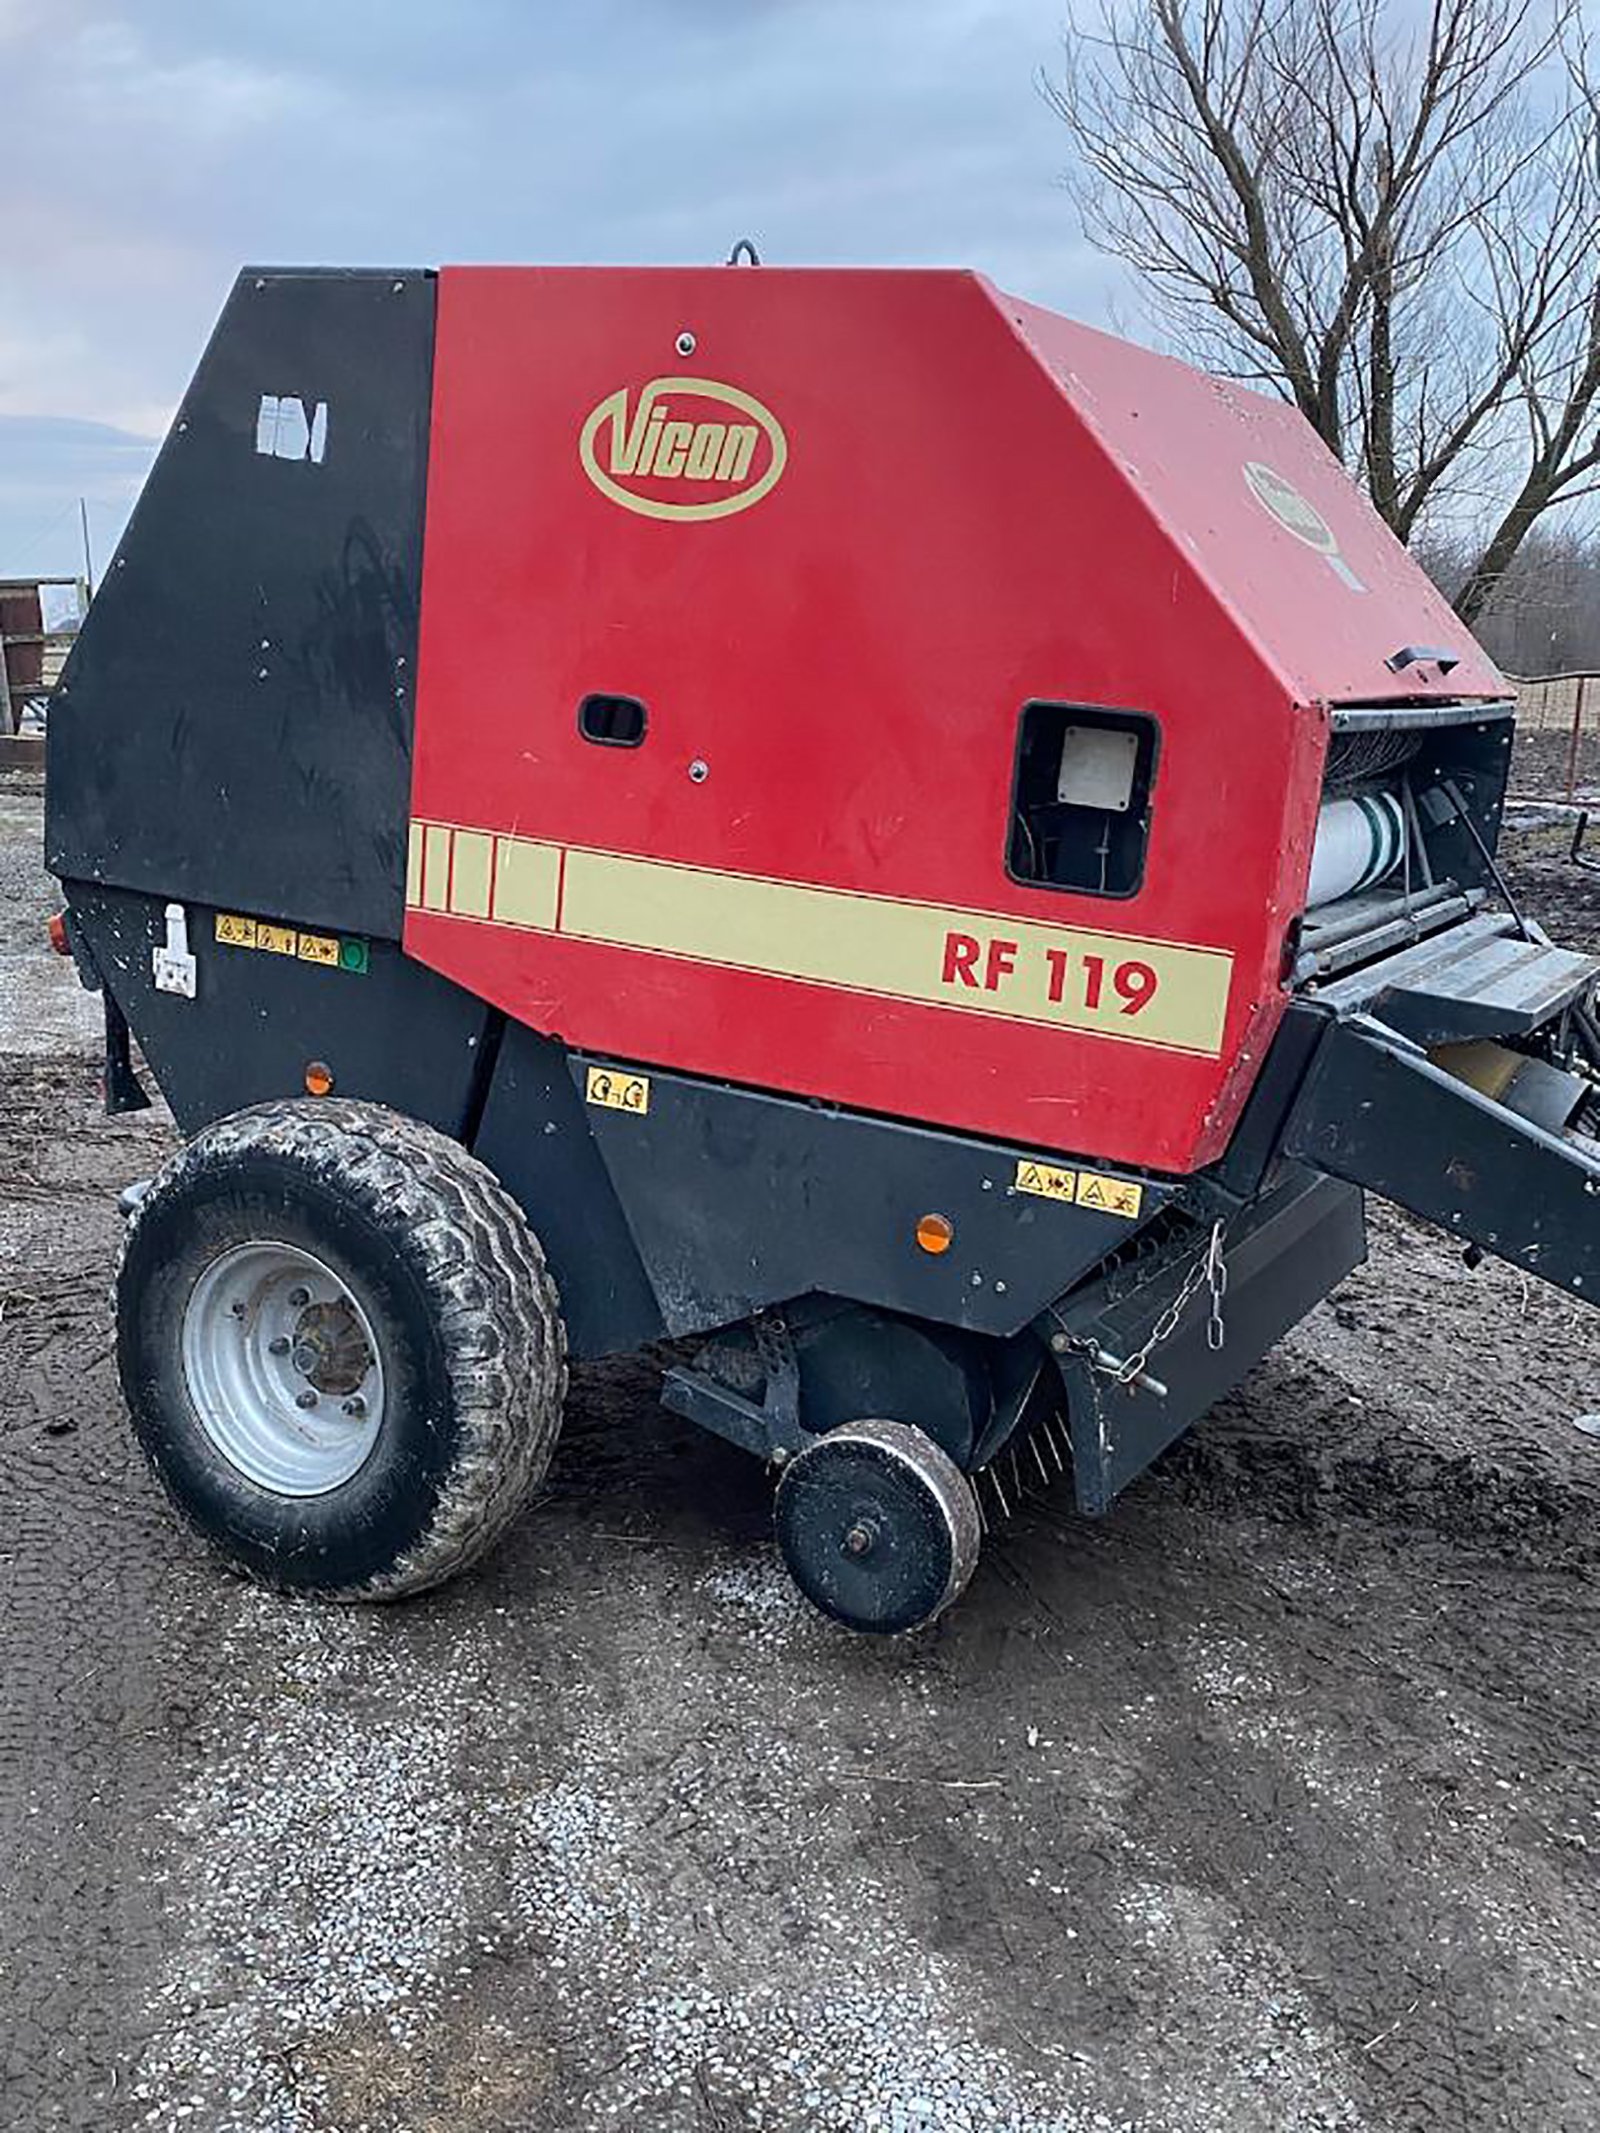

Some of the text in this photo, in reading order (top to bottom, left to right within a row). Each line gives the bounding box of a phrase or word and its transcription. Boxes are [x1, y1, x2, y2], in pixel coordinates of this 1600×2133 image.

[610, 386, 759, 481] Vicon
[942, 932, 1158, 1016] RF 119
